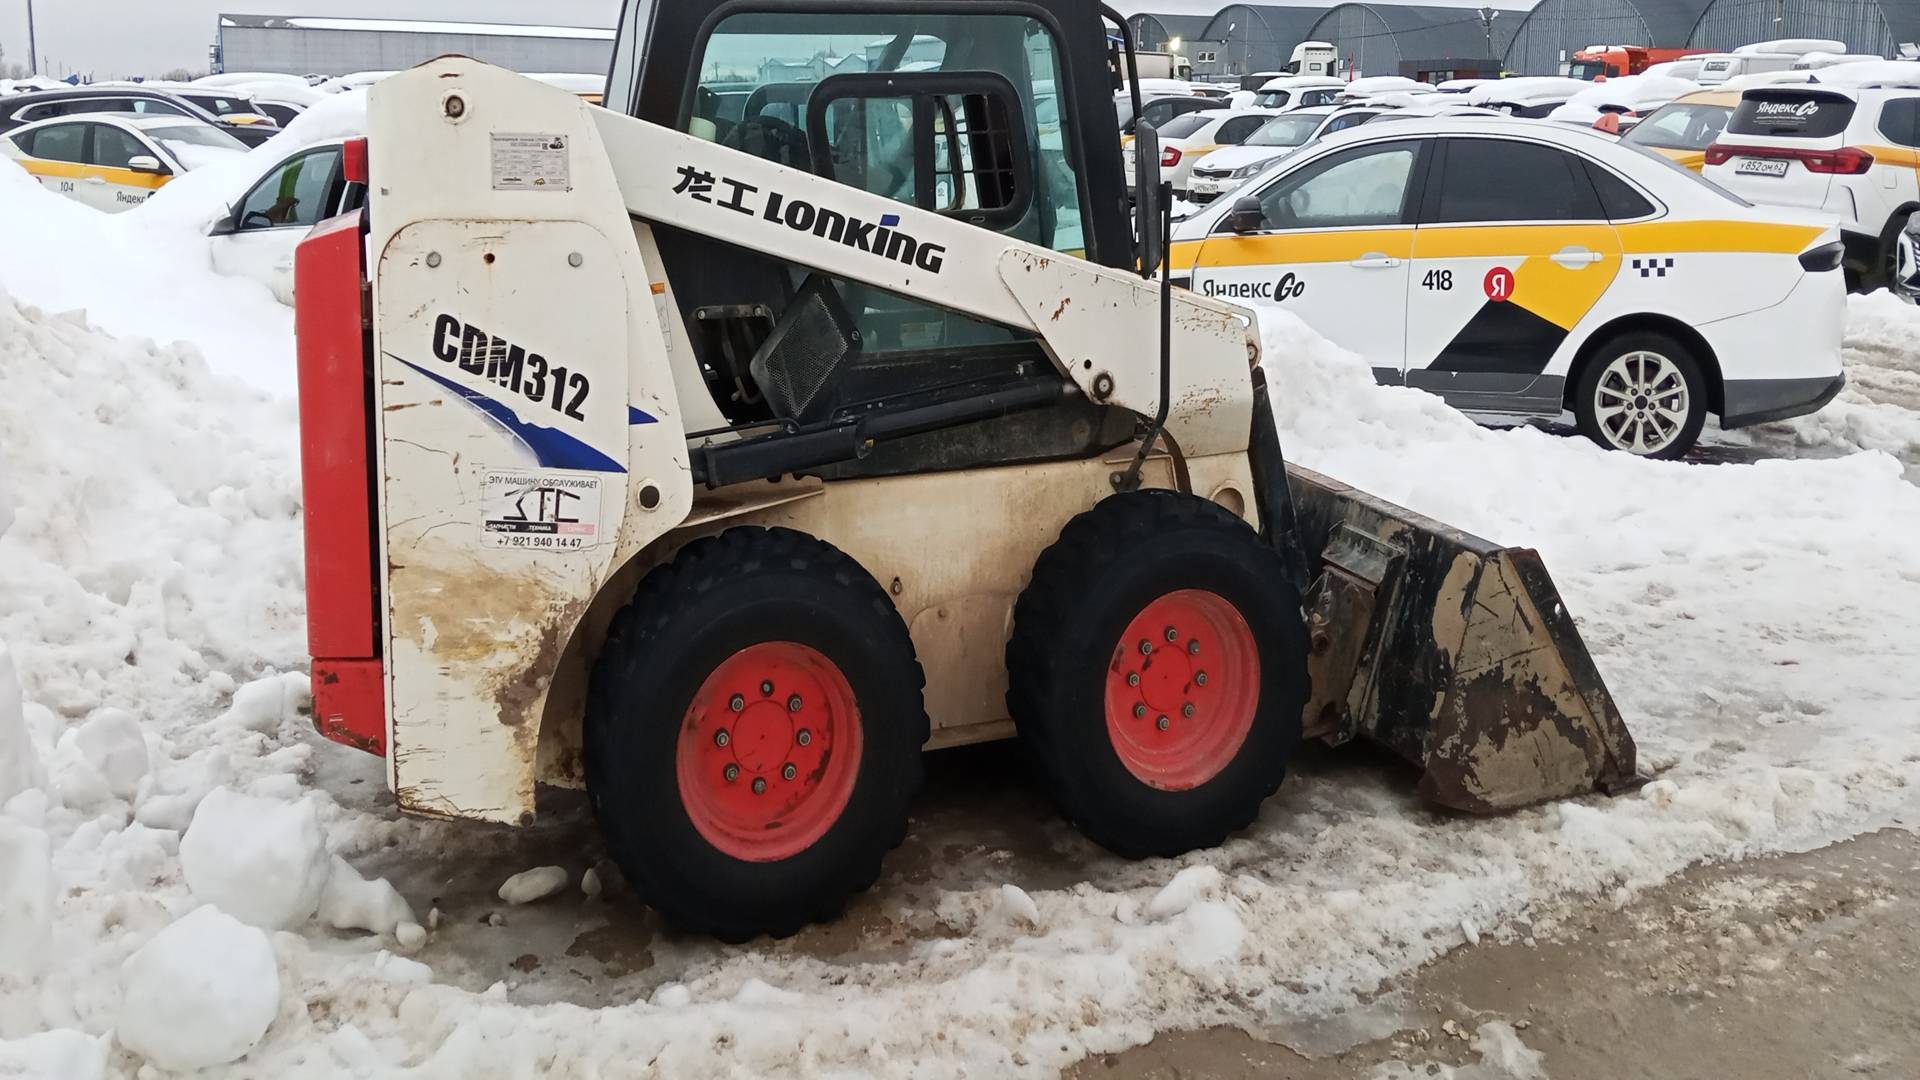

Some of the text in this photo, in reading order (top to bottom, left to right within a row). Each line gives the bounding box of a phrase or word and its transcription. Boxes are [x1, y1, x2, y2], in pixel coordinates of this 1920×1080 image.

[1756, 101, 1819, 116] Яндекс Go
[61, 182, 74, 192] 104
[1274, 272, 1305, 302] Go
[1422, 269, 1453, 291] 418
[1491, 274, 1506, 297] Я
[432, 313, 590, 422] CDM312
[489, 476, 597, 489] ЭТУ МАШИНУ ОБСЛУЖИВАЕТ
[497, 536, 582, 548] +7 921 940 14 47
